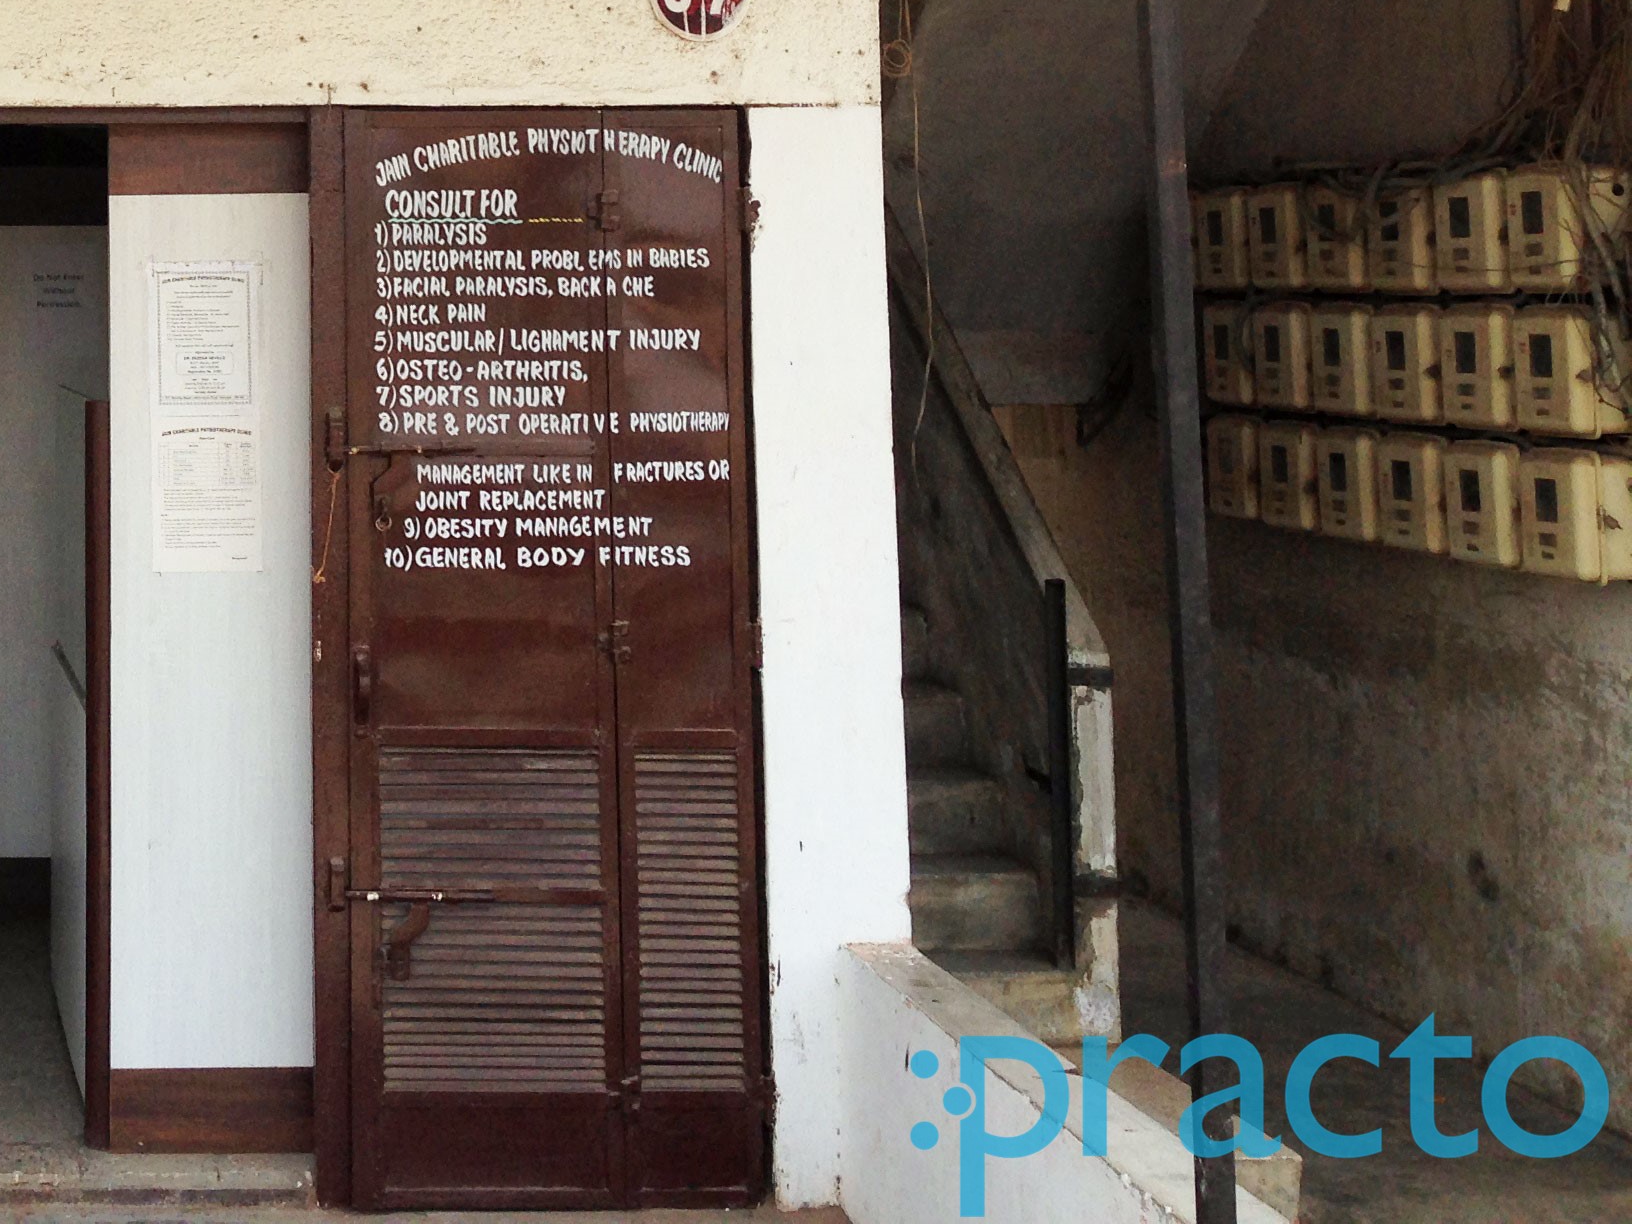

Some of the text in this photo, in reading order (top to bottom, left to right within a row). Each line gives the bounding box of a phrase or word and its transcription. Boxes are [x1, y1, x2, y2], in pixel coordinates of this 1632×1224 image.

[374, 152, 412, 187] JAIN
[413, 130, 521, 173] CHARITABLE
[672, 142, 723, 184] CLINIC
[384, 188, 518, 219] CONSULT FOR
[626, 247, 643, 267] IN
[649, 247, 711, 270] BABIES
[558, 276, 602, 297] BACK
[447, 303, 486, 324] PAIN
[629, 328, 702, 351] INJURY
[489, 385, 566, 408] INJURY
[443, 412, 460, 436] &
[466, 413, 511, 435] POST
[630, 410, 730, 433] PHYSIOTHERAPY
[417, 463, 525, 485] MANAGEMENT
[532, 464, 573, 485] LIKE
[576, 463, 593, 483] IN
[708, 458, 730, 481] OR
[415, 488, 606, 512] JOINT REPLACEMENT
[515, 516, 653, 538] MANAGEMENT
[517, 546, 584, 567] BODY
[599, 545, 691, 567] FITNESS
